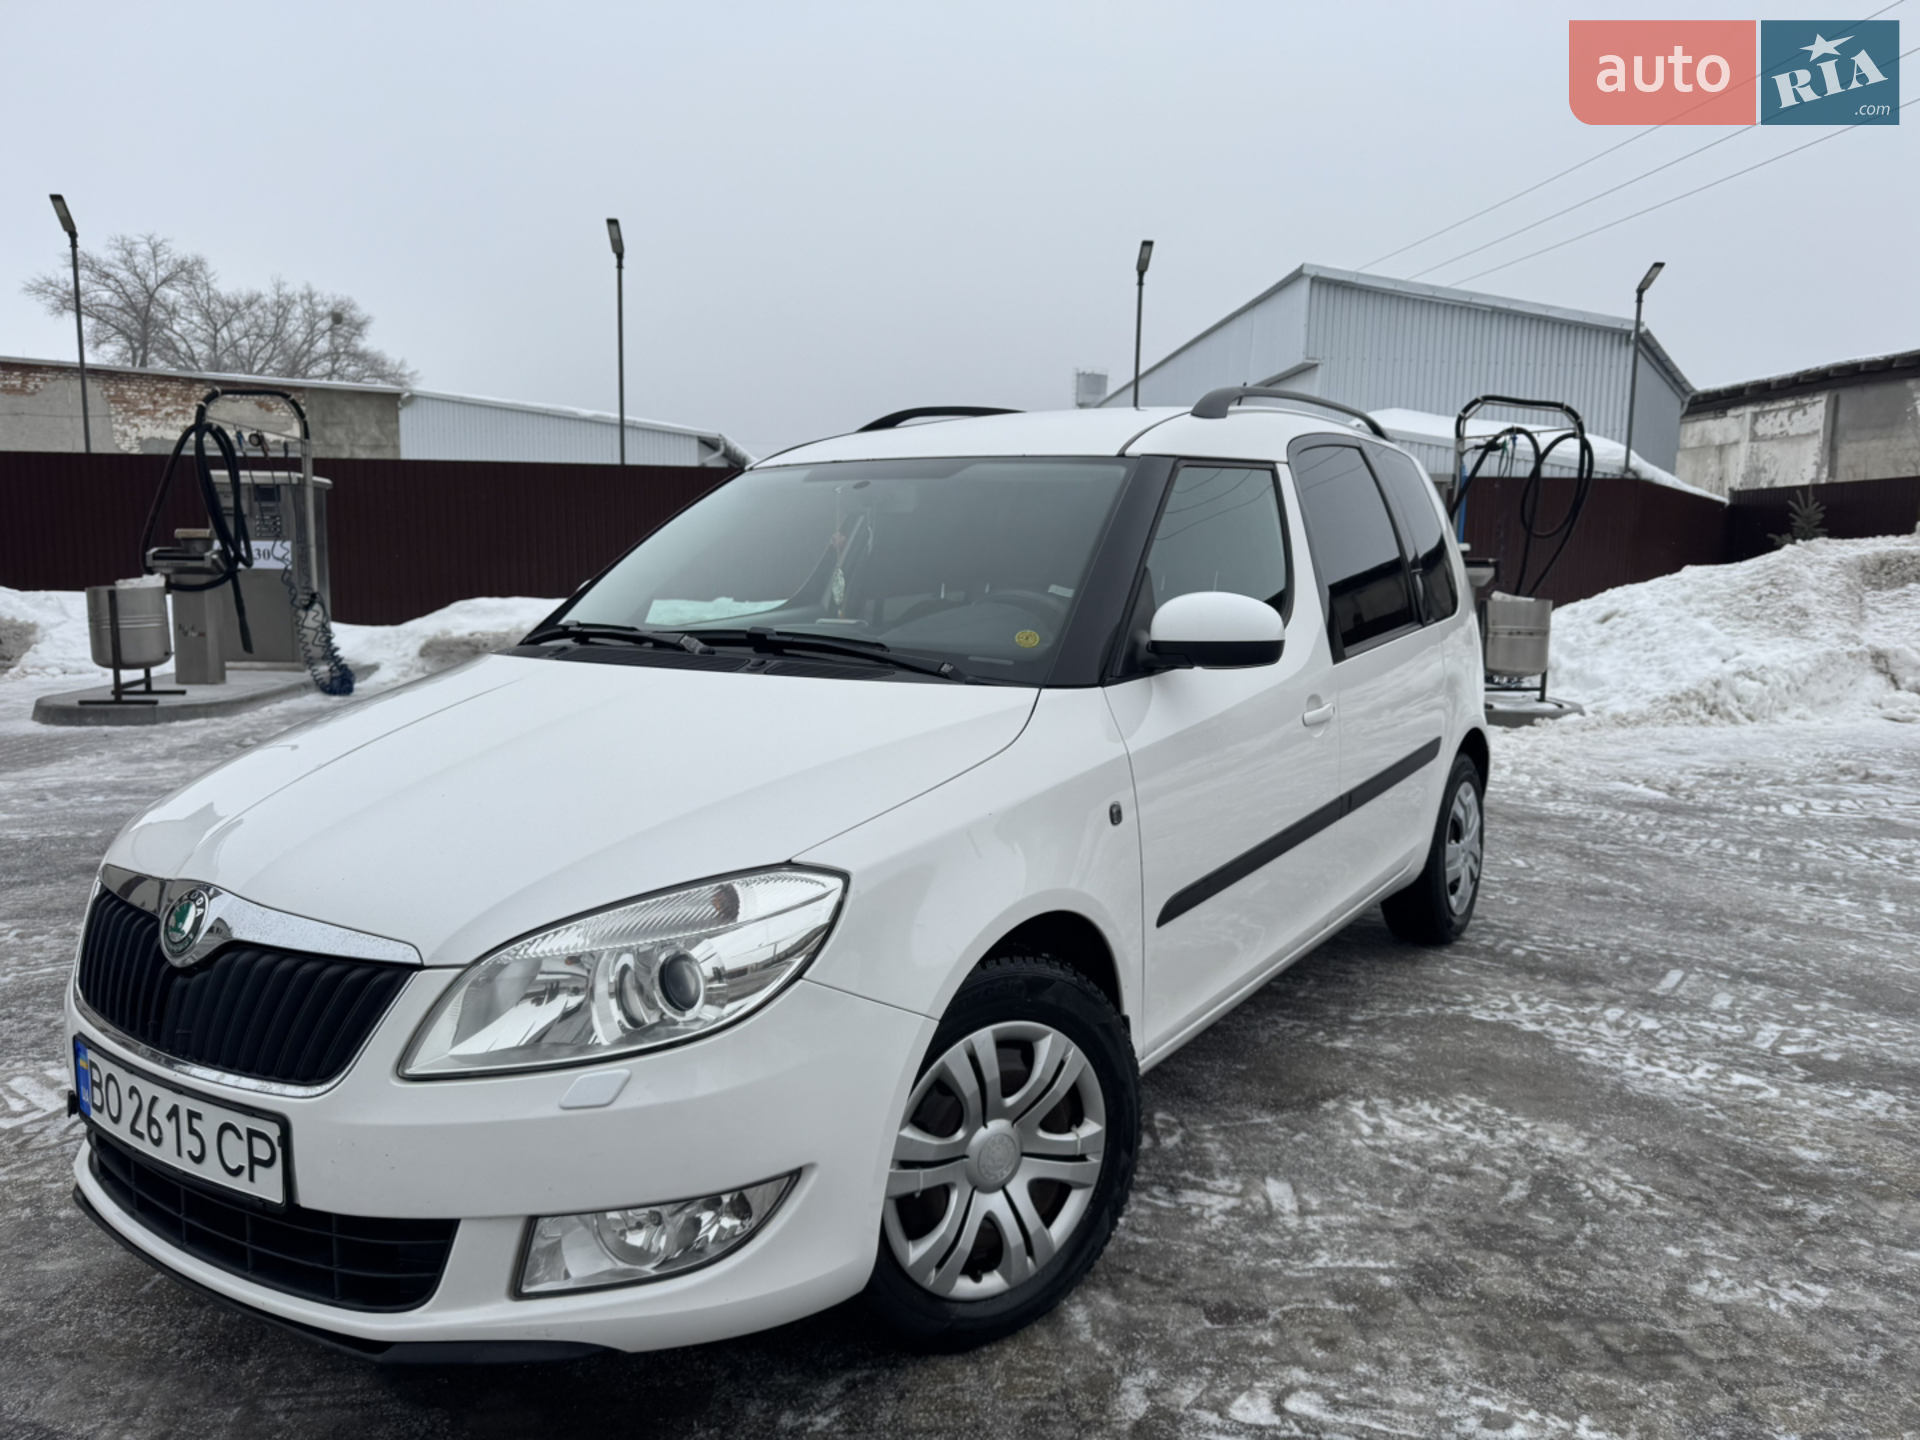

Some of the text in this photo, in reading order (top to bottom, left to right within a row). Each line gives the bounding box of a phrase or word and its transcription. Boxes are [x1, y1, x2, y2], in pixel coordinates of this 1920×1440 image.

[89, 1059, 277, 1183] BO 2615 CP
